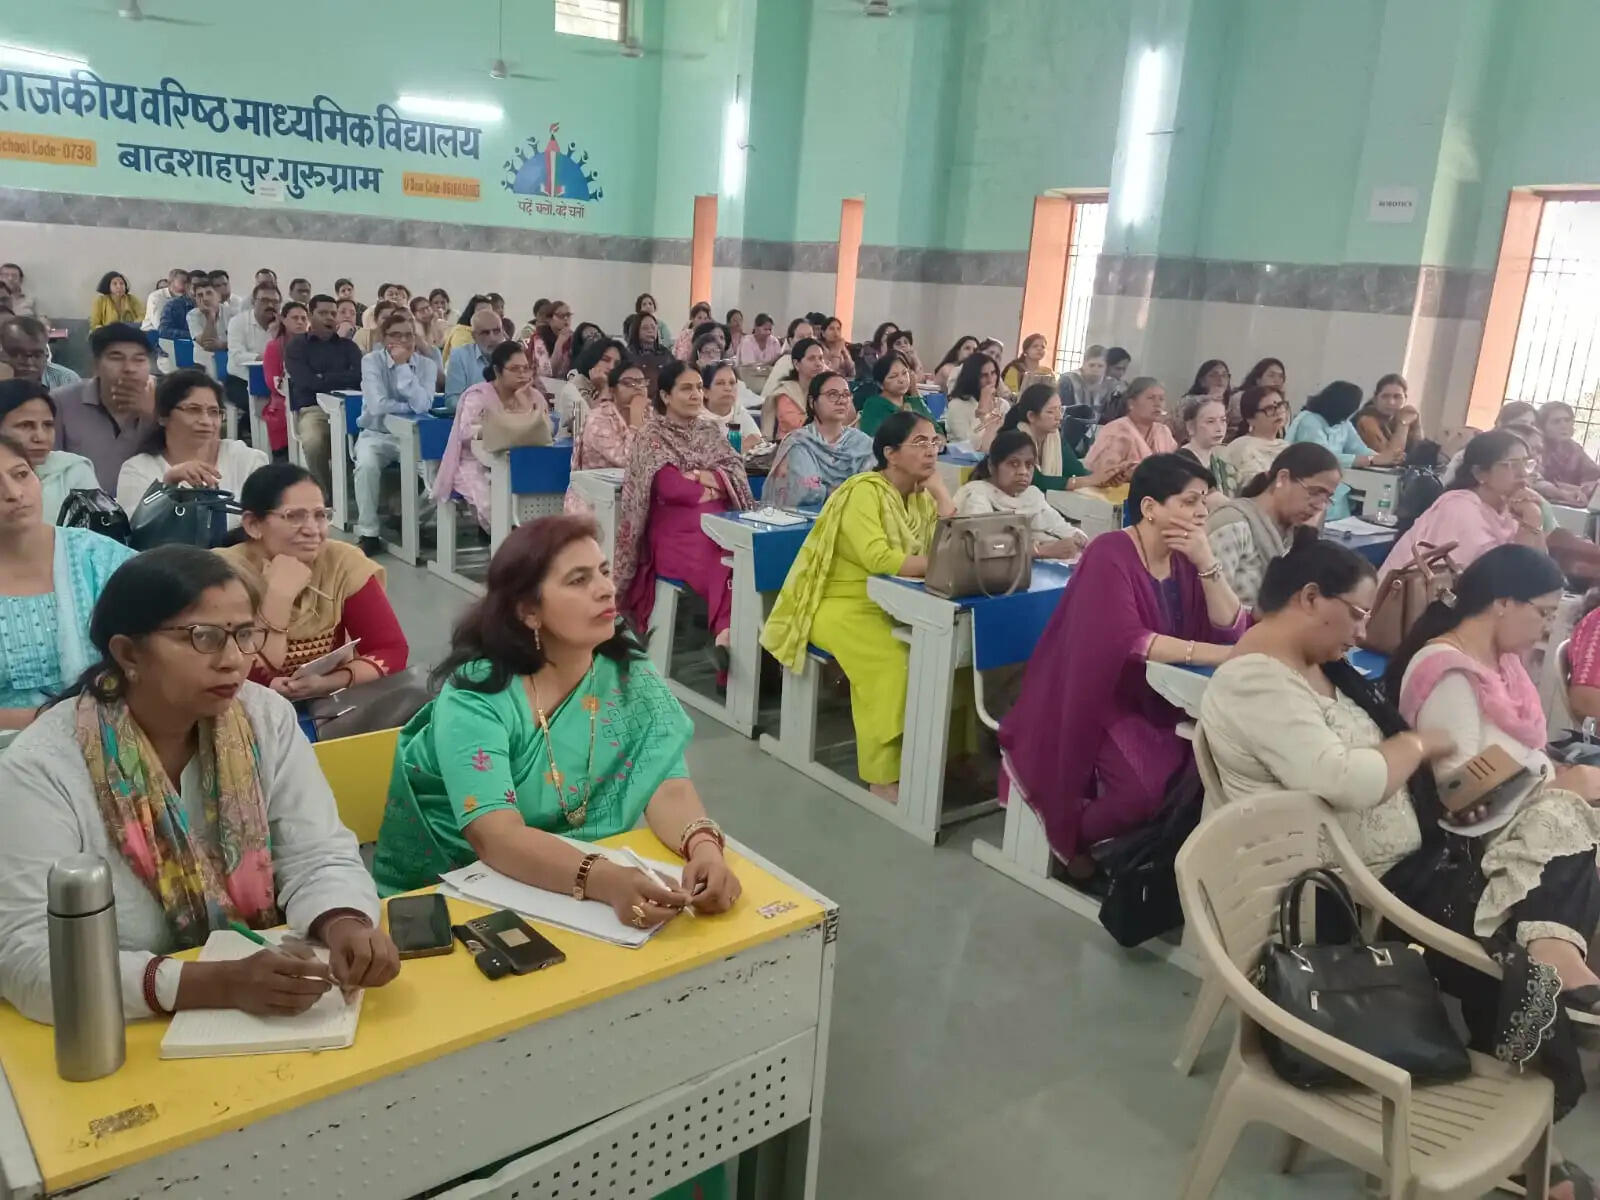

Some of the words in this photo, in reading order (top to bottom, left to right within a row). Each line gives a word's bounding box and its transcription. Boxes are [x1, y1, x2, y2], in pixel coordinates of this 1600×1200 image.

[141, 77, 230, 133] वरिष्ठ
[231, 95, 373, 148] माध्यमिक
[374, 104, 482, 160] विद्यालय
[0, 136, 30, 154] chool
[278, 158, 384, 199] गुरुग्राम
